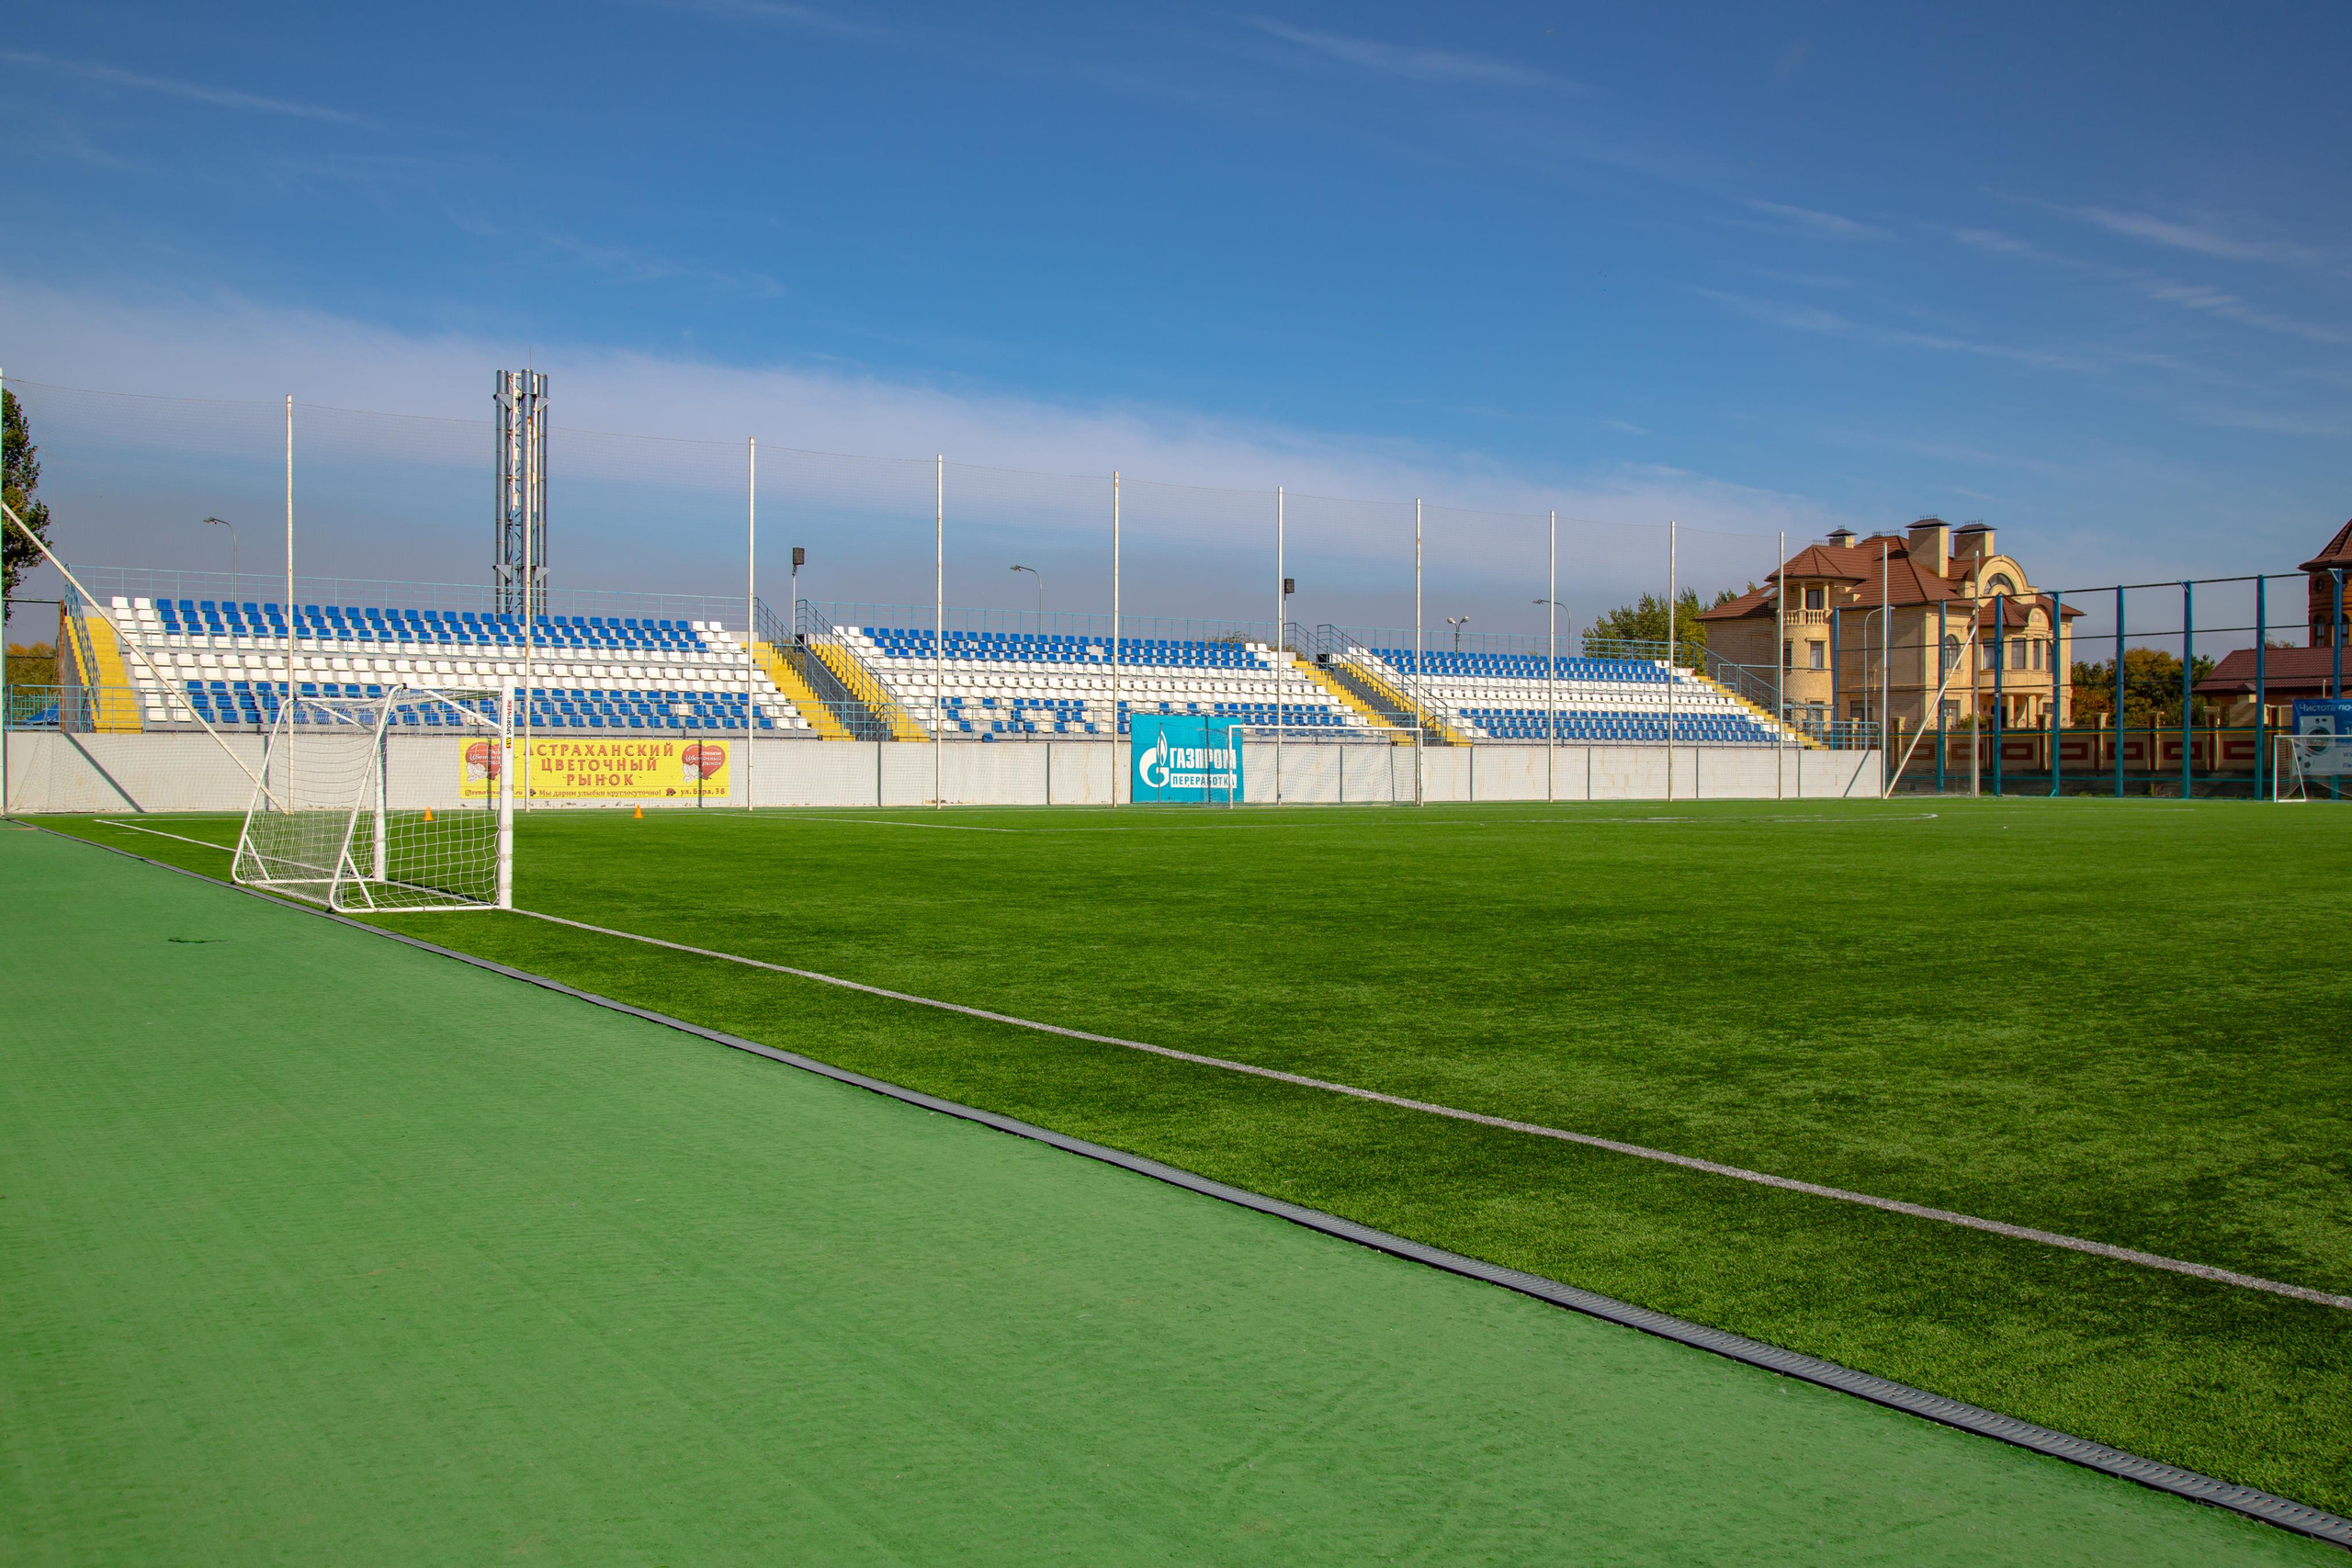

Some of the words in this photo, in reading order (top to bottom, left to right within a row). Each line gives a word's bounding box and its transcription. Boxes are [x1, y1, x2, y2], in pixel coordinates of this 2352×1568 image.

[2300, 704, 2336, 712] Чистота
[523, 742, 673, 757] АСТРАХАНСКИЙ
[541, 757, 657, 773] ЦВЕТОЧНЫЙ
[1170, 748, 1237, 769] ГАЗПРОМ
[566, 773, 634, 786] РЫНОК
[553, 790, 576, 798] дарим
[578, 789, 605, 797] улыбки
[606, 789, 662, 797] круглосуточно!
[693, 788, 714, 796] Бра,
[716, 787, 726, 795] 38
